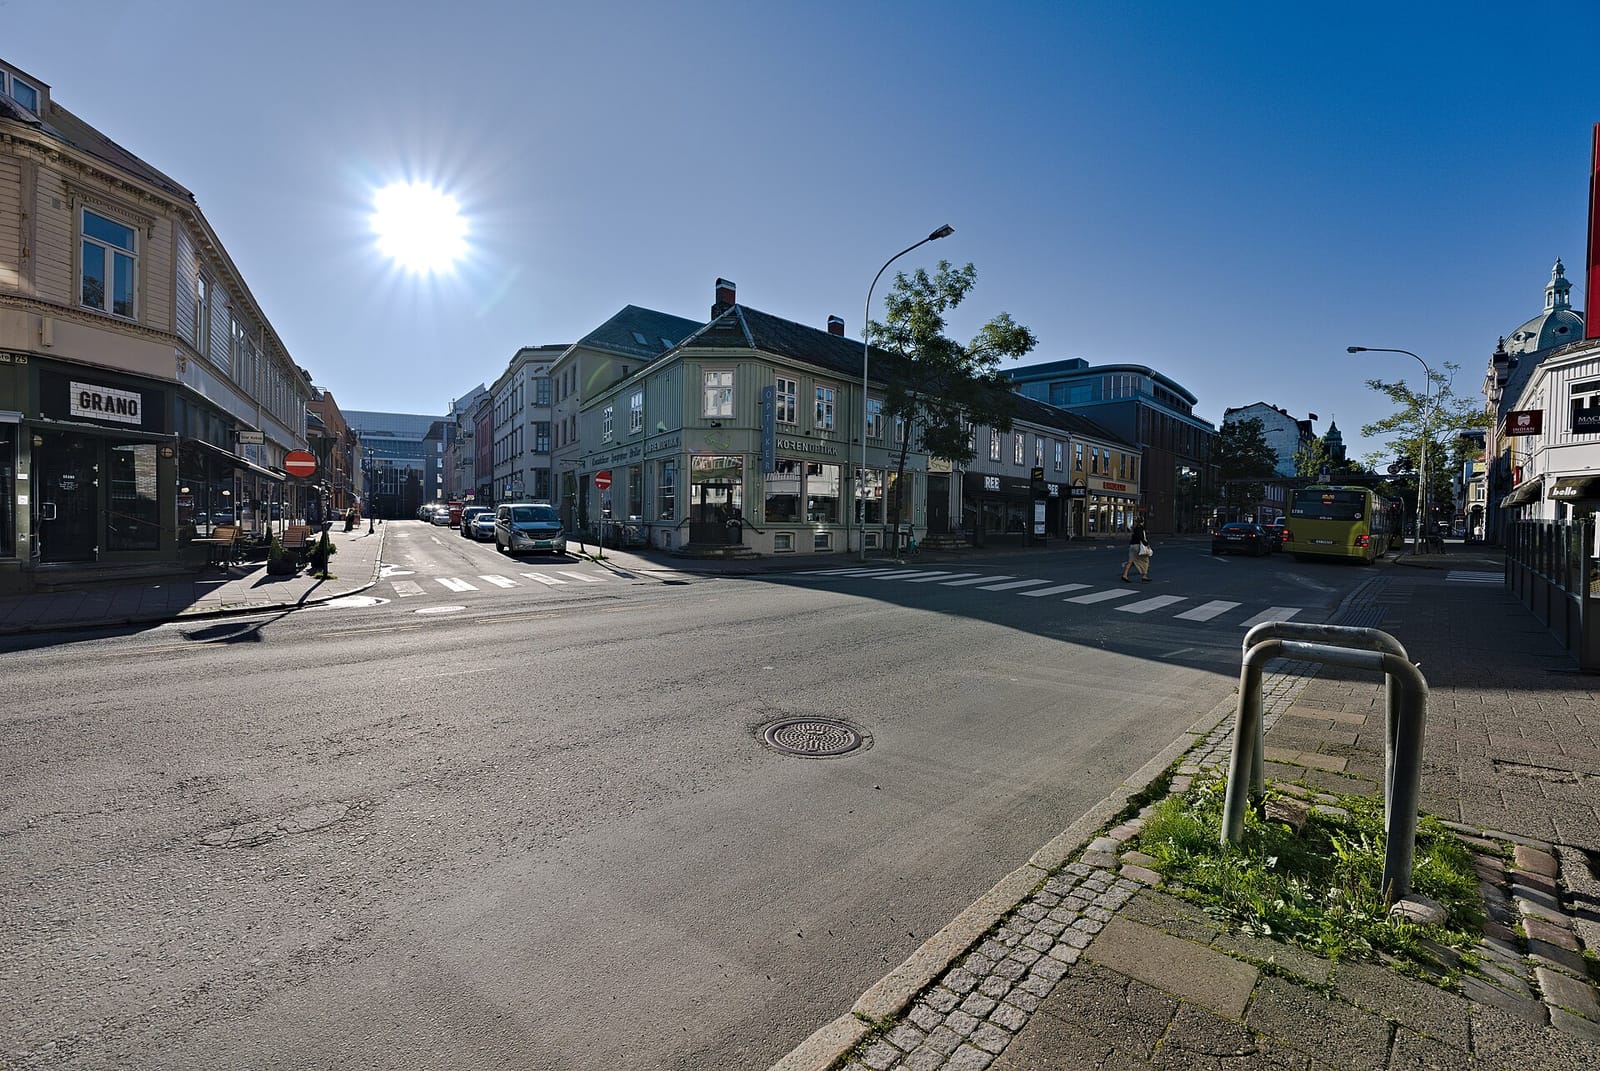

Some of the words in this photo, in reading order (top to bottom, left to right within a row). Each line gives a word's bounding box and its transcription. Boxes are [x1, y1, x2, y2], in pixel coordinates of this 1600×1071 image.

[16, 355, 27, 363] 25
[79, 391, 138, 416] GRANO
[764, 390, 773, 470] OPTIKER
[1551, 486, 1577, 496] bello
